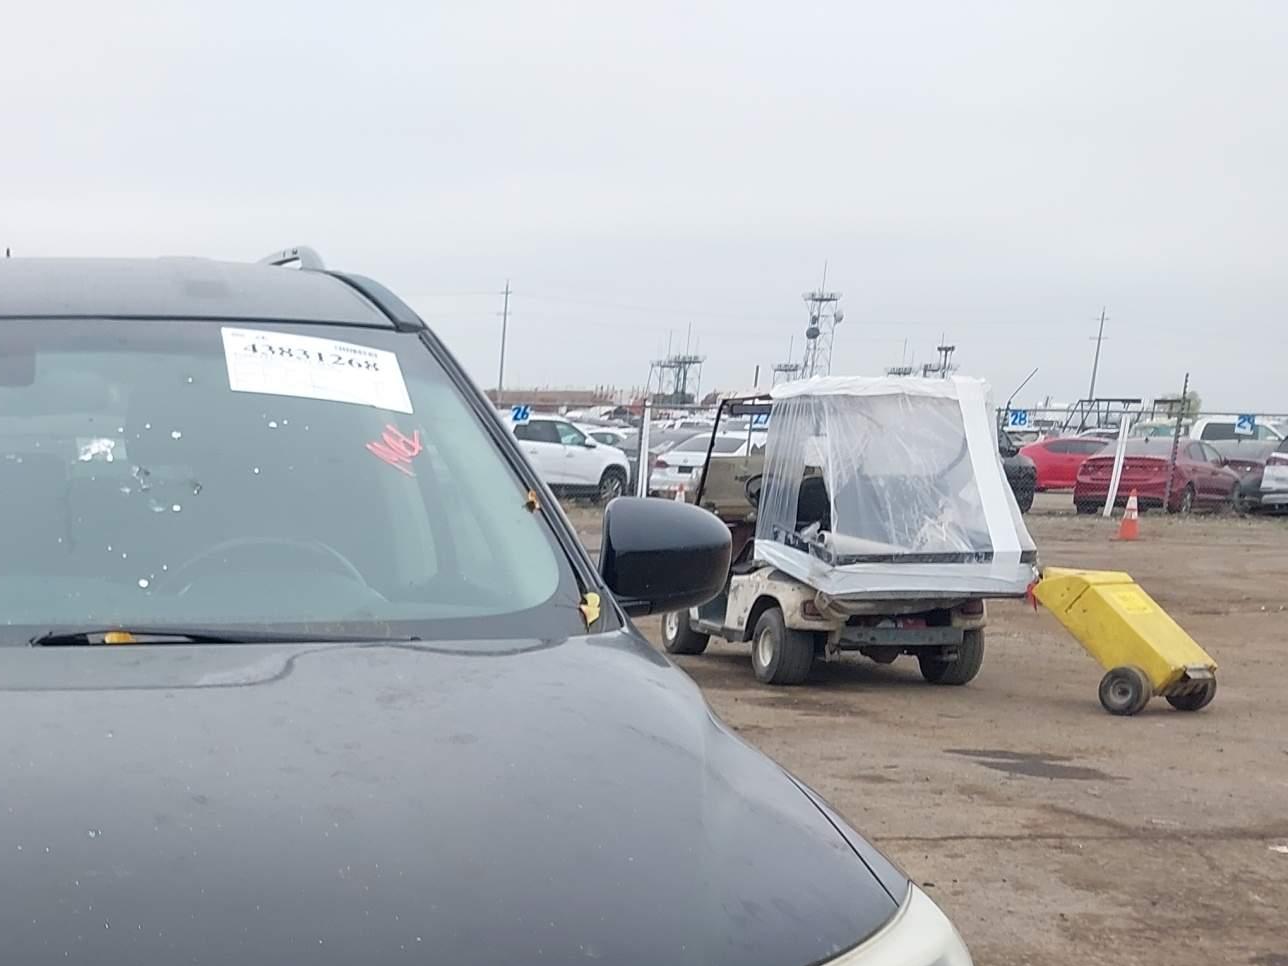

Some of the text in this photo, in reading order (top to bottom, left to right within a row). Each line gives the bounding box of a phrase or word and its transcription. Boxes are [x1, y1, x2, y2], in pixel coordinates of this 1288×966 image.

[244, 343, 380, 372] 43831268
[512, 404, 529, 421] 26
[1011, 410, 1027, 426] 28
[1237, 414, 1256, 432] 29
